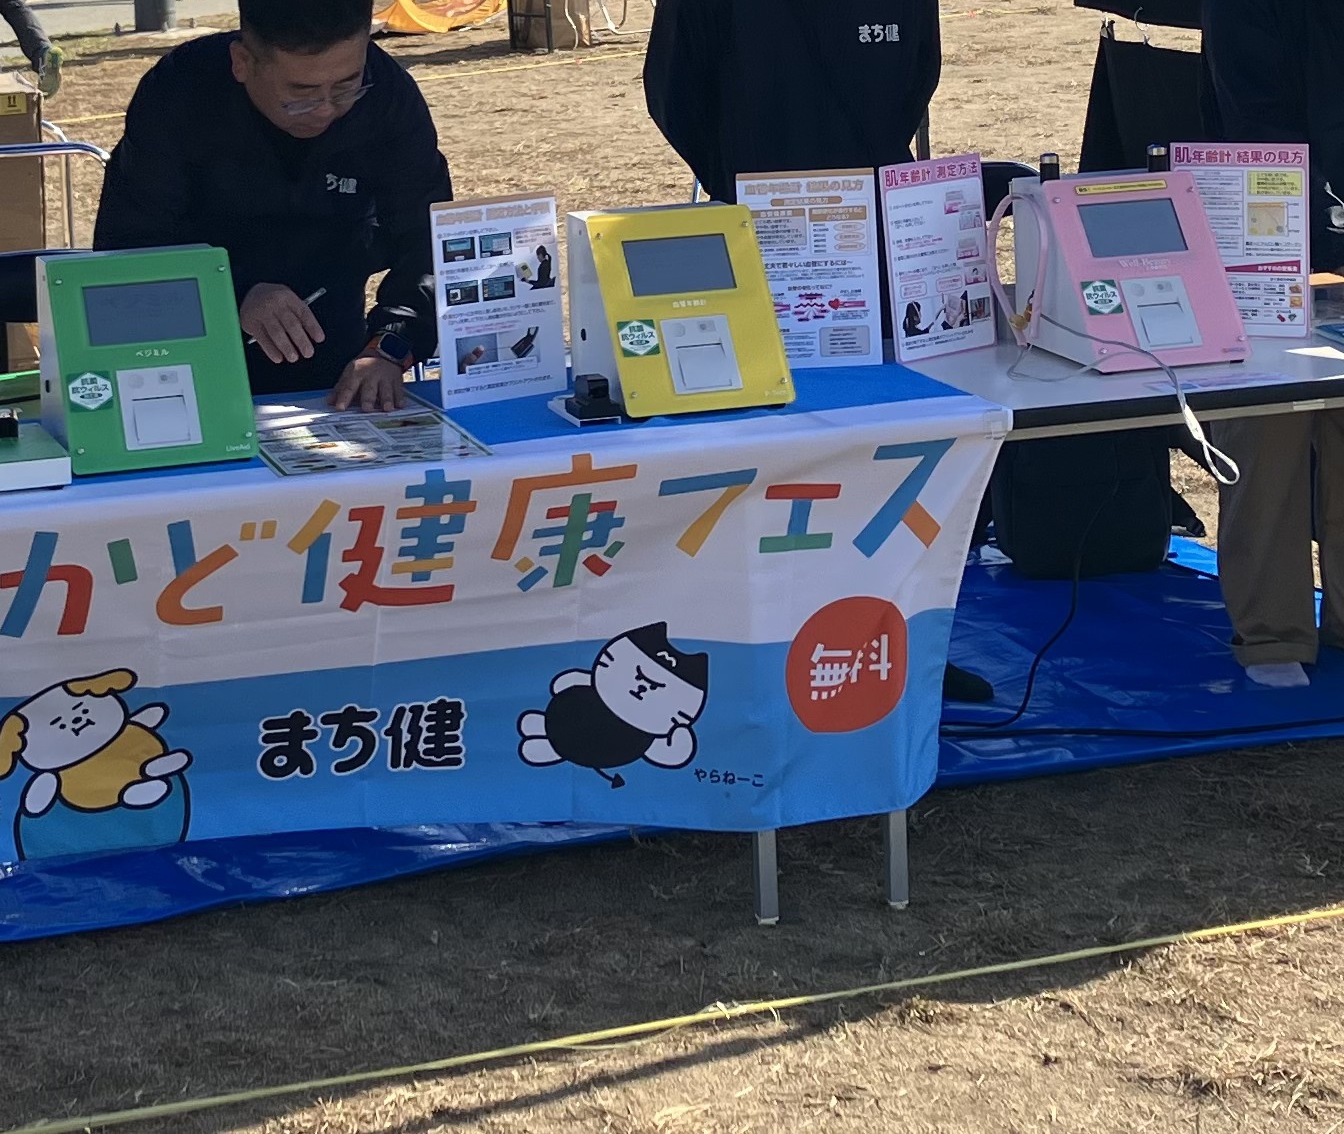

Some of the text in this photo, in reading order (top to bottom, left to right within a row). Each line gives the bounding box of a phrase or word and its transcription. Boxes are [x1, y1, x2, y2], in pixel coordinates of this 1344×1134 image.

[858, 23, 900, 43] まち健
[1174, 146, 1304, 164] 肌年齢計 結果の見方
[884, 161, 978, 187] 肌年齢計 測定方法
[809, 633, 892, 701] 無料
[258, 696, 467, 780] まち健
[693, 768, 764, 787] やらねーこ
